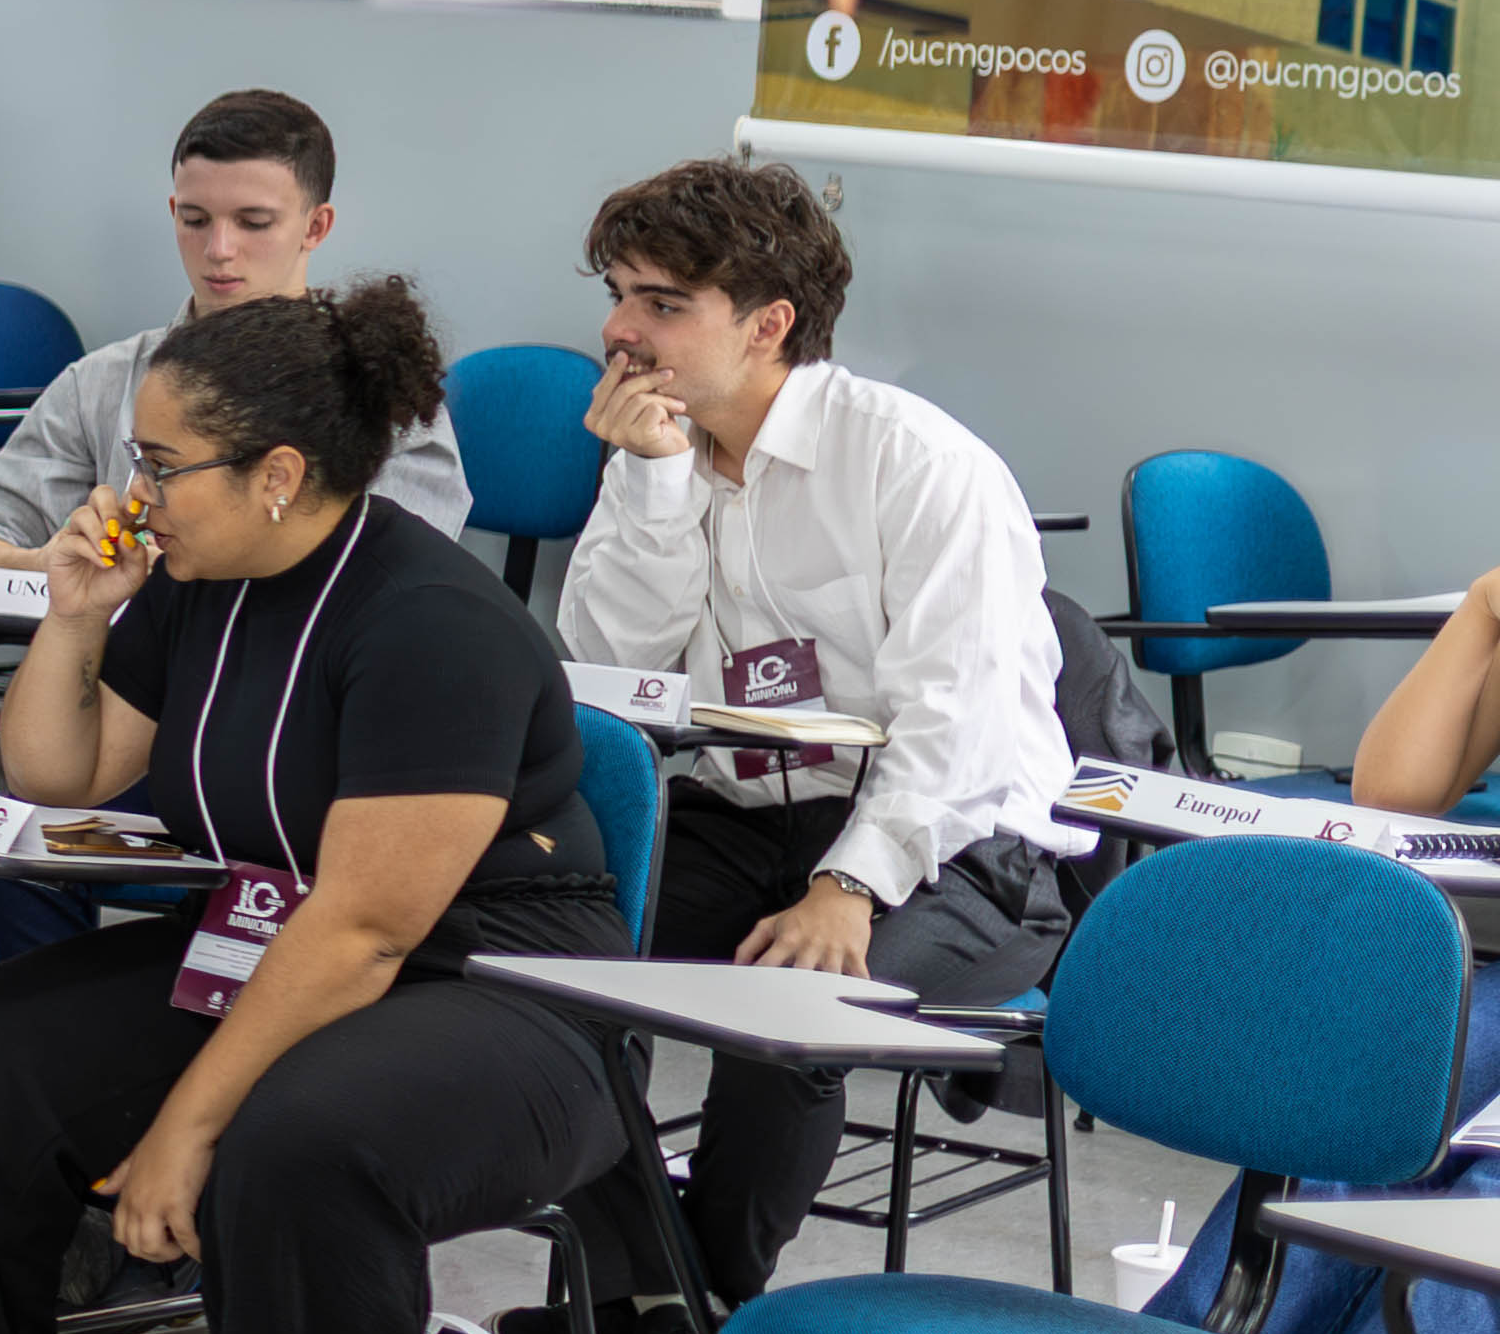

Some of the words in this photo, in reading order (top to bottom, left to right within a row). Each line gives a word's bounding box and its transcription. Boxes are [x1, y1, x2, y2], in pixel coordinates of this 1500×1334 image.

[878, 28, 1086, 78] /pucmgpocos
[1204, 50, 1460, 98] @pucmgpocos
[745, 681, 798, 704] MINIONU
[1175, 792, 1262, 825] Europol
